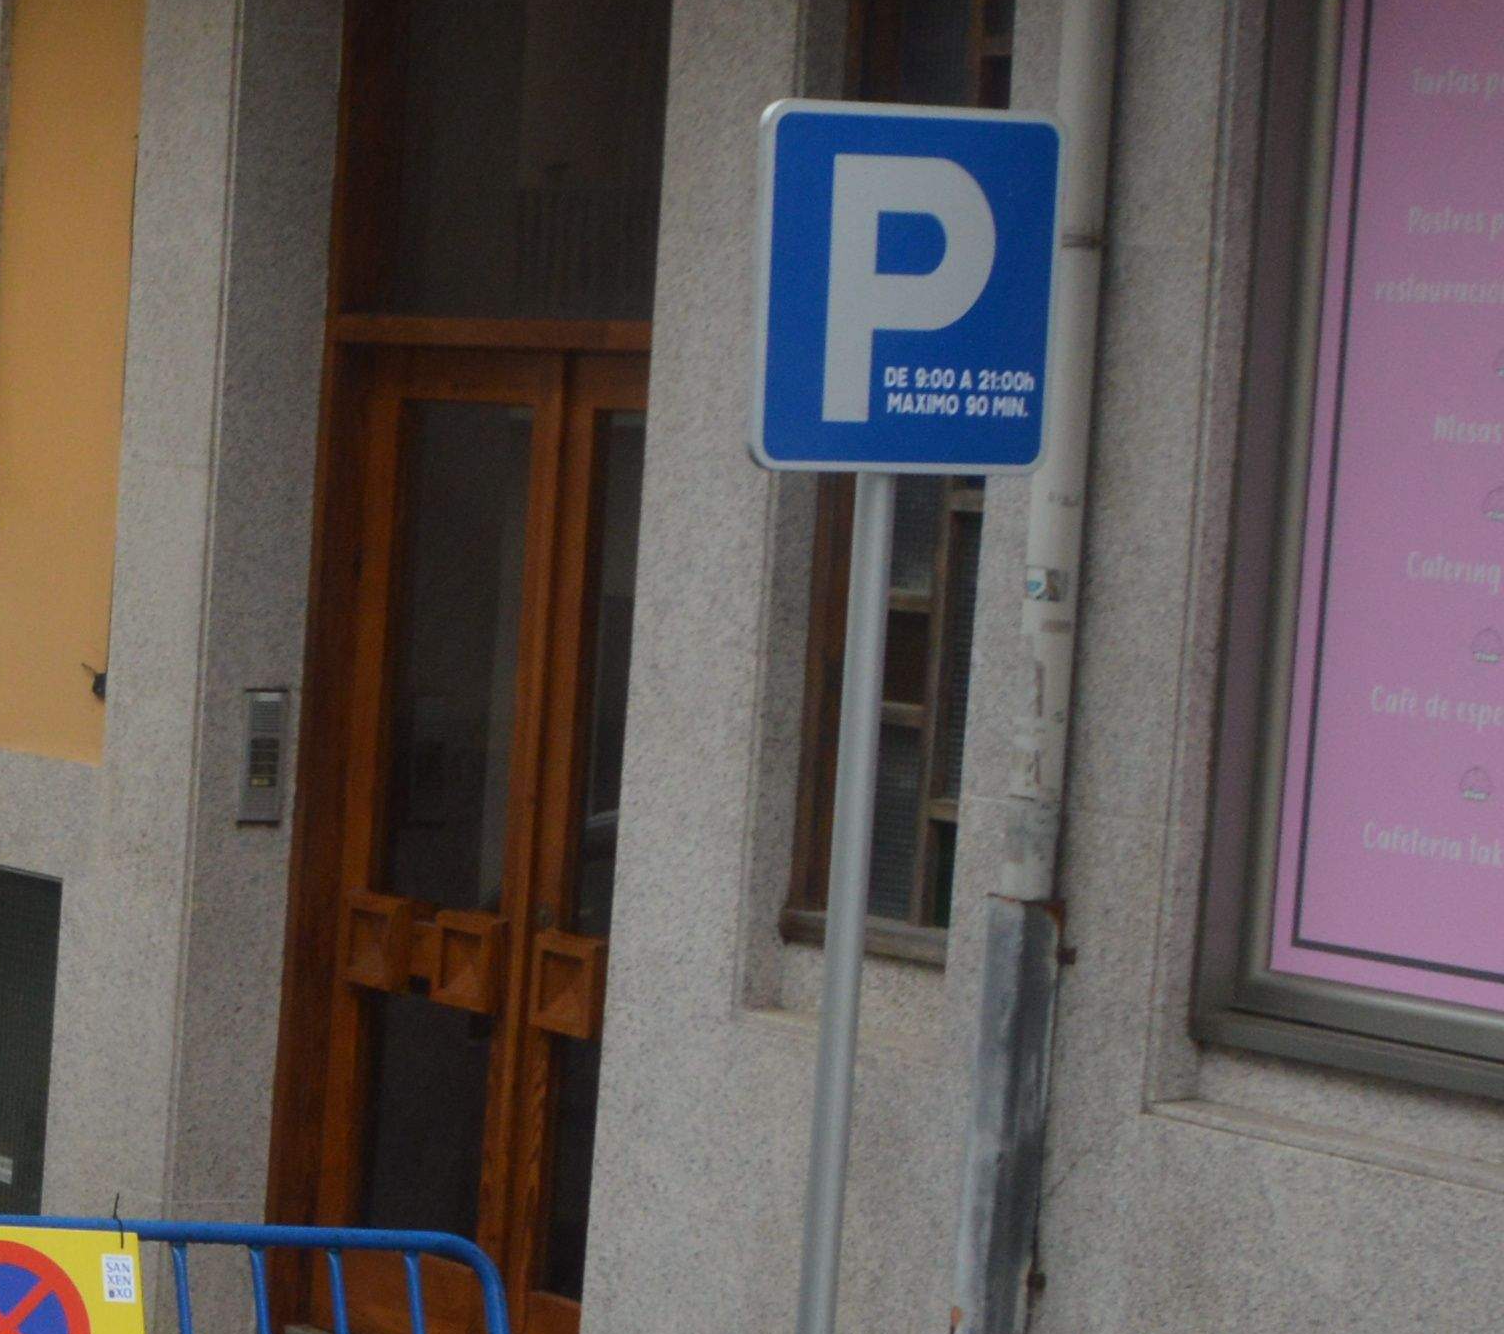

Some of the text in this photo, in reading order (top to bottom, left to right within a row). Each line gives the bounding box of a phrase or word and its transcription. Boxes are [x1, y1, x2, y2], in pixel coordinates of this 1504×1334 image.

[822, 153, 996, 423] P
[884, 366, 1036, 392] DE 9:00 A 21:00h
[887, 392, 959, 416] MAXIMO
[965, 395, 989, 417] 90
[105, 1262, 131, 1273] SAN
[106, 1274, 132, 1285] XEN
